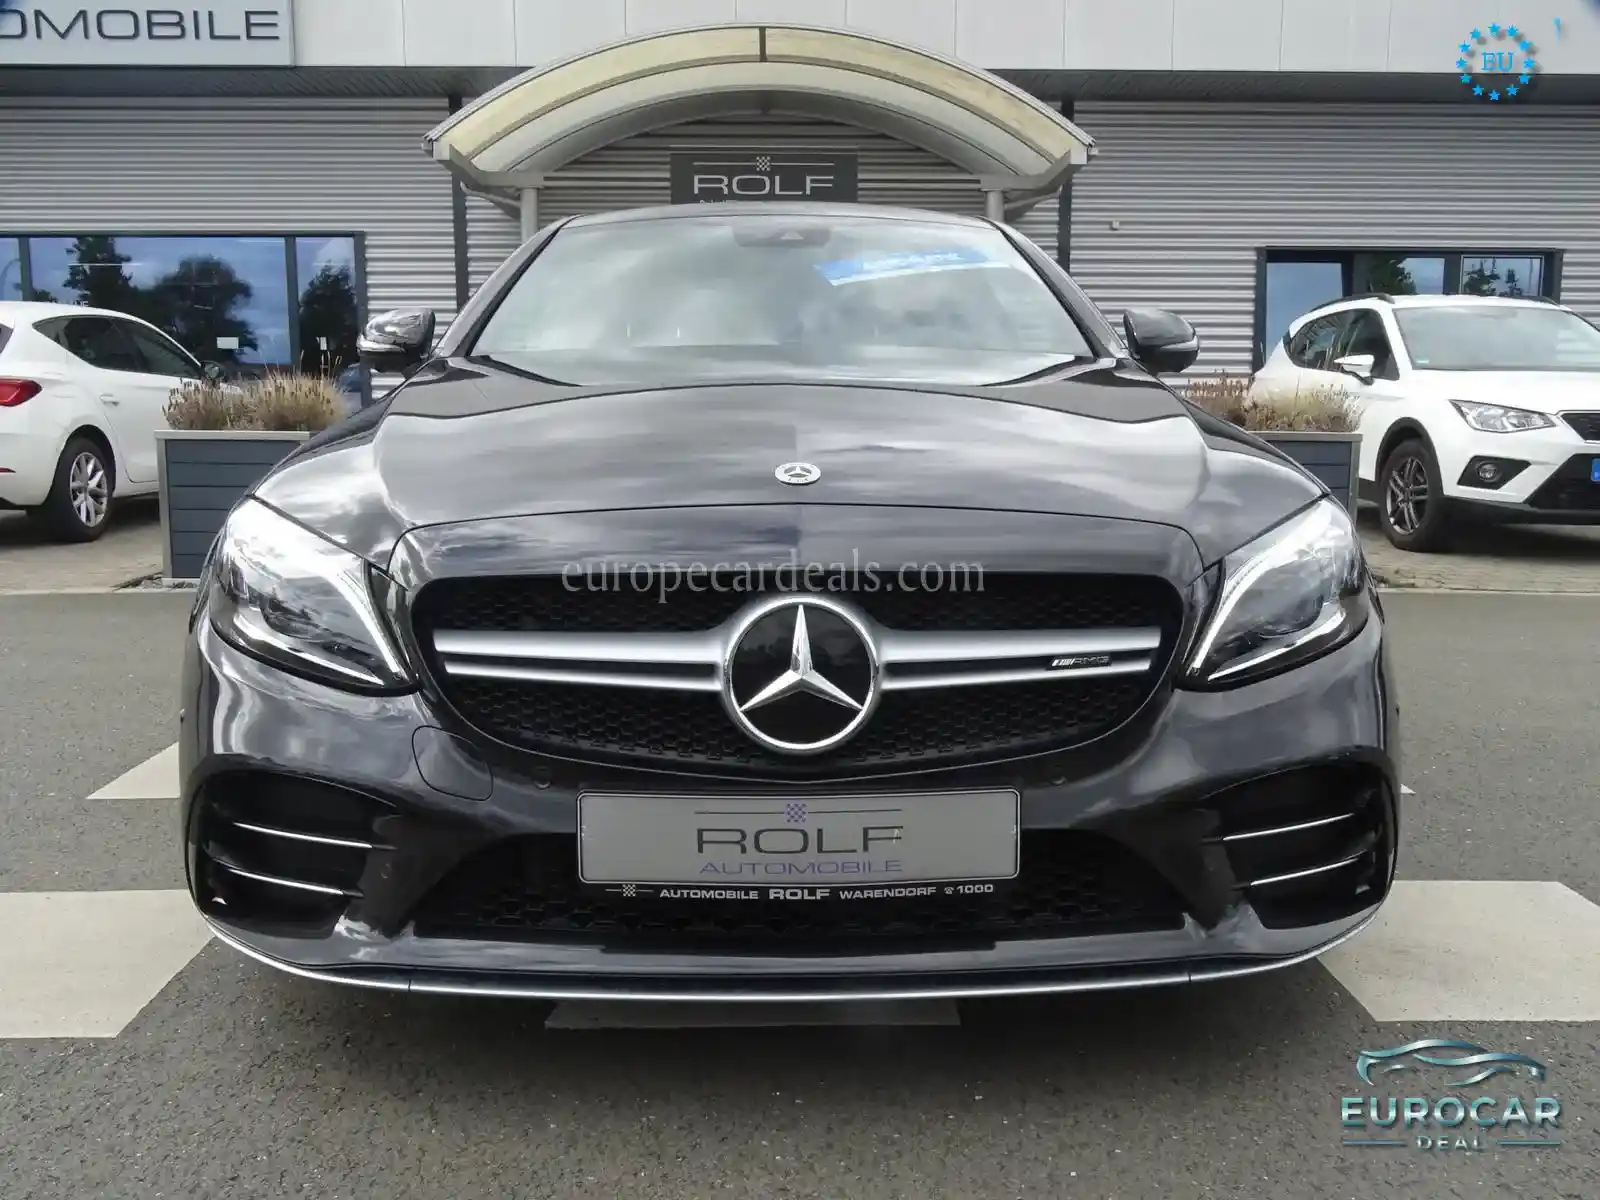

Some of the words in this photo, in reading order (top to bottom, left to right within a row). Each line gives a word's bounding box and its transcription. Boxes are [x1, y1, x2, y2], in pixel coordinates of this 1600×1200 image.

[693, 174, 835, 196] ROLF
[697, 825, 904, 854] ROLF
[699, 859, 903, 875] AUTOMOBILE
[659, 888, 759, 900] AUTOMOBILE
[768, 888, 831, 900] ROLF
[839, 886, 937, 900] WARENDORF
